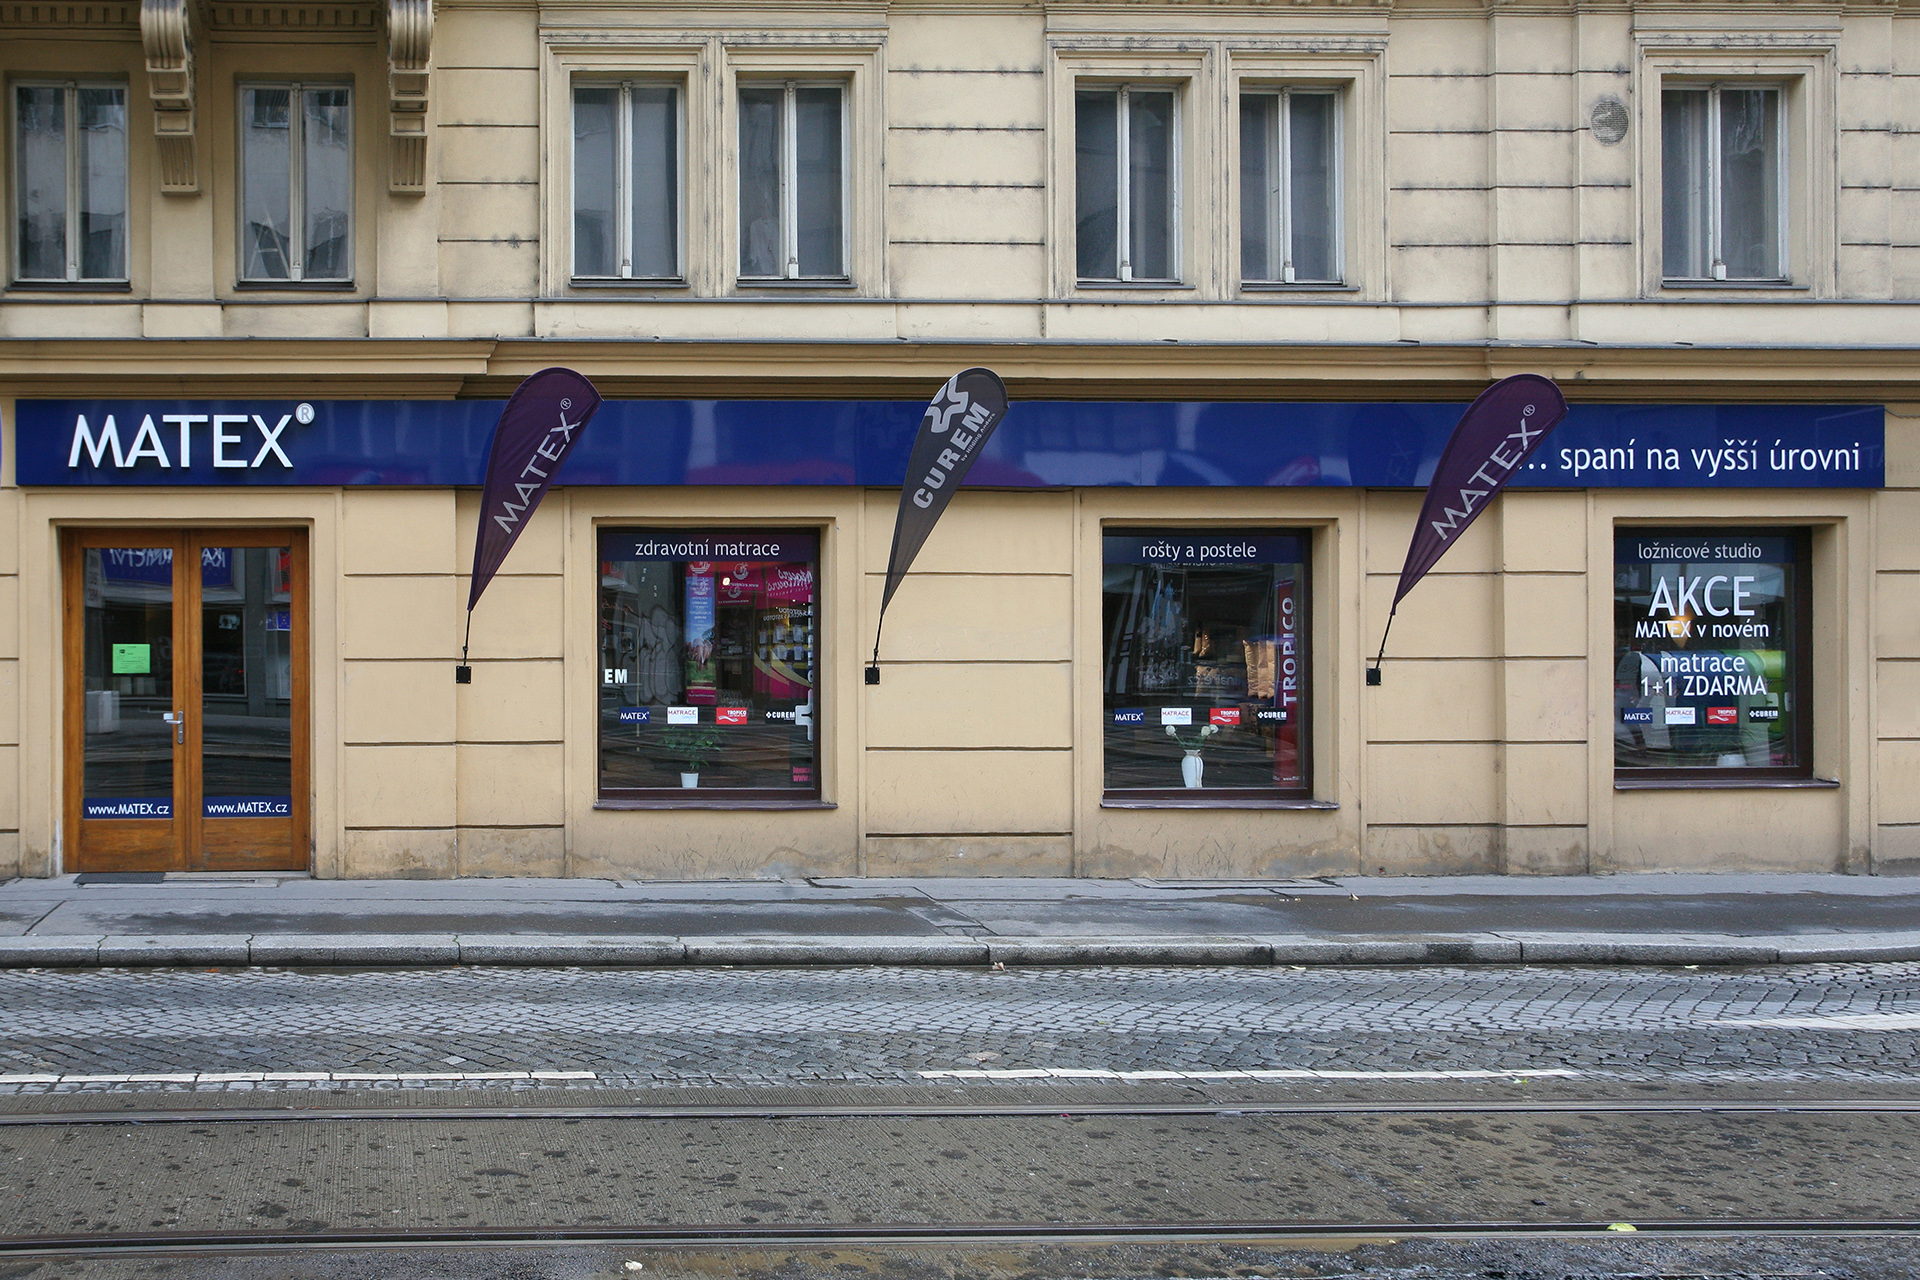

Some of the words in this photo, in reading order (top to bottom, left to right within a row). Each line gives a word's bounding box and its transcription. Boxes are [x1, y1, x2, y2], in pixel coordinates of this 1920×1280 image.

[912, 401, 991, 509] CUREM
[1560, 438, 1636, 477] spaní
[1646, 445, 1681, 470] na
[1691, 438, 1759, 477] vyšší
[1769, 438, 1861, 470] úrovni
[635, 538, 710, 556] zdravotní
[714, 541, 780, 556] matrace
[1142, 540, 1181, 561] rošty
[1186, 545, 1195, 558] a
[1200, 541, 1257, 561] postele
[1638, 542, 1709, 559] ložnicové
[1714, 543, 1762, 559] studio
[1648, 575, 1756, 618] AKCE
[1635, 620, 1692, 638] MATEX
[1696, 624, 1708, 638] v
[1712, 618, 1770, 638] novém
[1282, 597, 1298, 706] TROPICO
[1660, 653, 1746, 673] matrace
[604, 668, 628, 684] EM
[1640, 676, 1674, 698] 1+1
[1683, 675, 1768, 696] ZDARMA
[771, 711, 795, 719] CUREM
[1263, 711, 1287, 719] CUREM
[1755, 710, 1779, 718] CUREM
[88, 803, 170, 815] www.MATEX.cz
[207, 801, 288, 813] www.MATEX.cz
